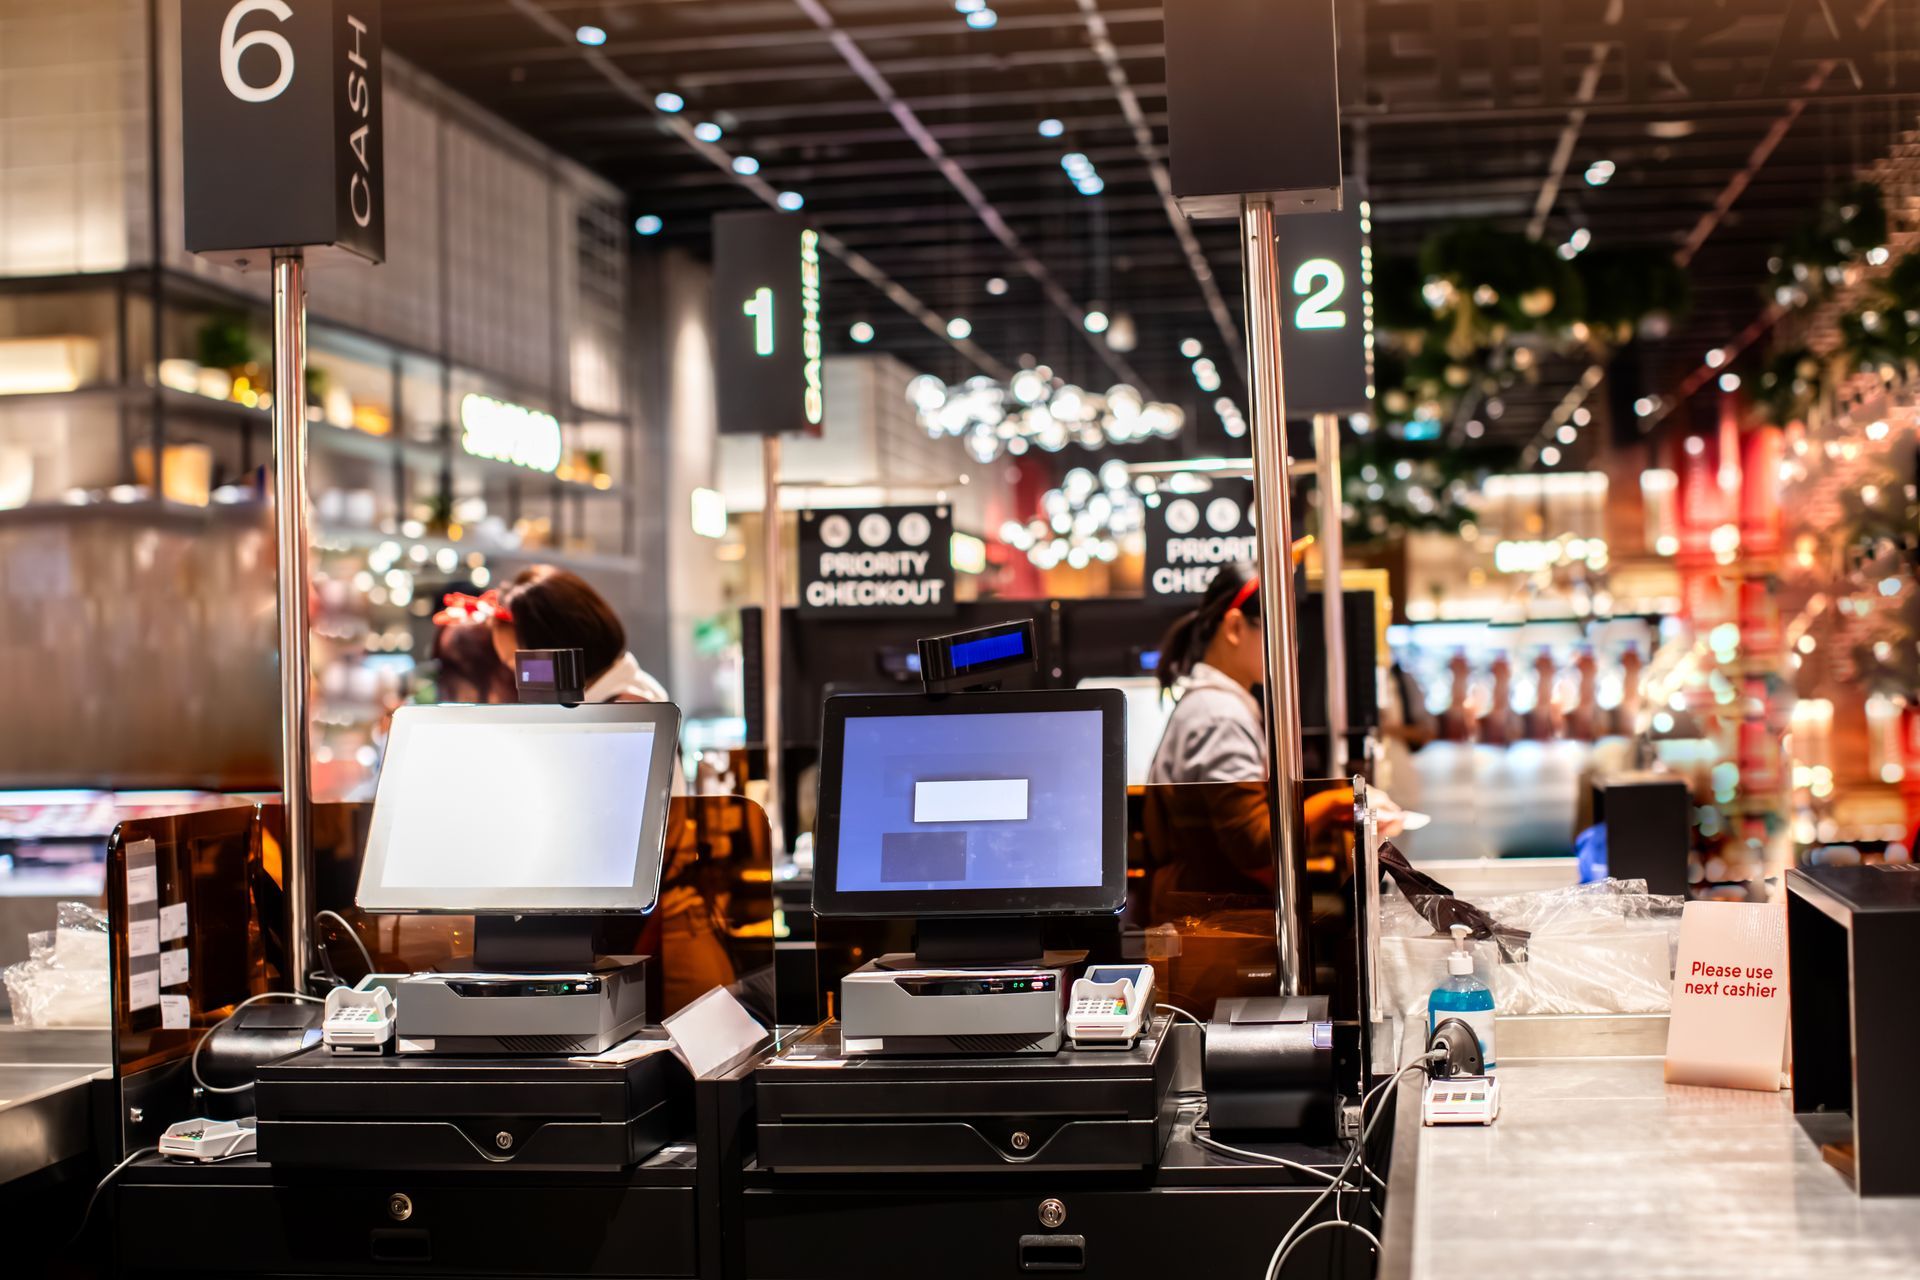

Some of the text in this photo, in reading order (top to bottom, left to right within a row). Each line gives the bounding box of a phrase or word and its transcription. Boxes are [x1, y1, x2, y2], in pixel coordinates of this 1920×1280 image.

[220, 0, 295, 103] 6
[347, 14, 371, 228] CASH
[1293, 258, 1347, 330] 2
[743, 287, 775, 356] 1
[1166, 536, 1257, 564] PRIORIT
[820, 551, 930, 578] PRIORITY
[806, 579, 945, 607] CHECKOUT
[1692, 961, 1773, 980] Please use
[1685, 981, 1777, 998] next cashier
